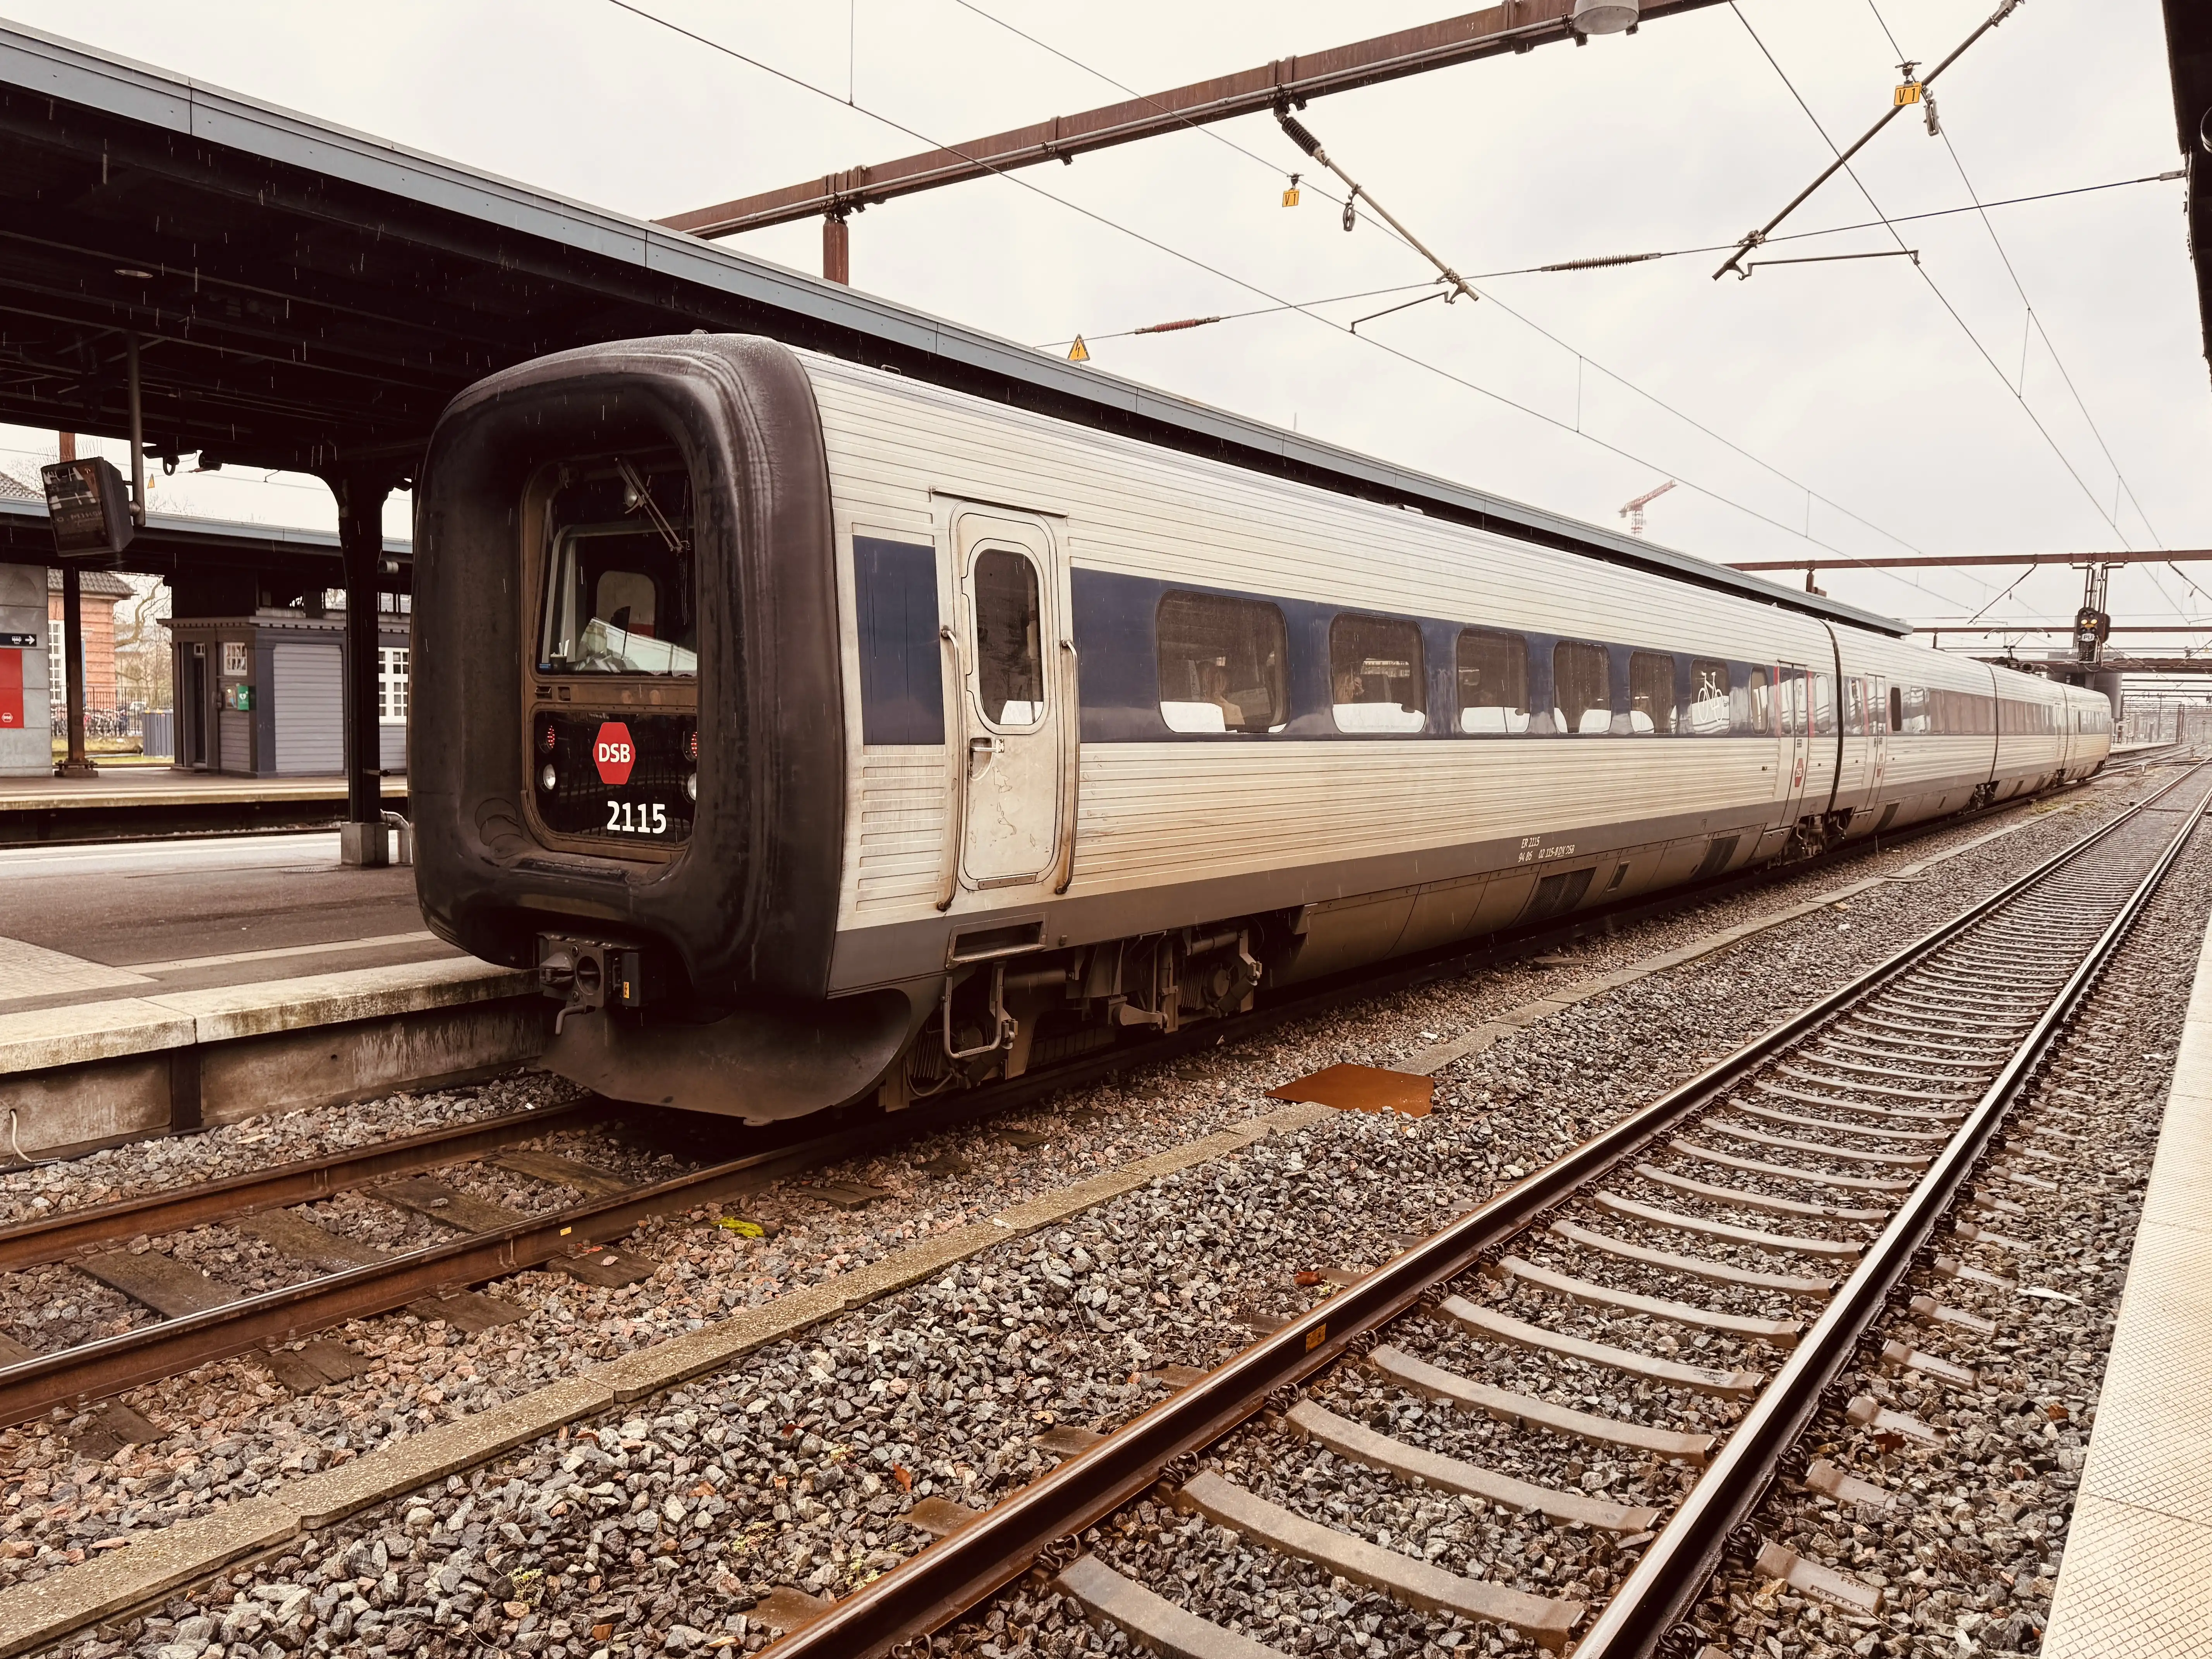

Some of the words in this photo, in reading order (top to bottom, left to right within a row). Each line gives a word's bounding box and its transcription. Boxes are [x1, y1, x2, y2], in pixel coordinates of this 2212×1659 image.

[599, 743, 630, 763] DSB
[607, 801, 666, 834] 2115
[1521, 838, 1528, 848] ER
[1528, 836, 1540, 847] 2115
[1518, 852, 1525, 862] 94
[1538, 848, 1545, 859] 02
